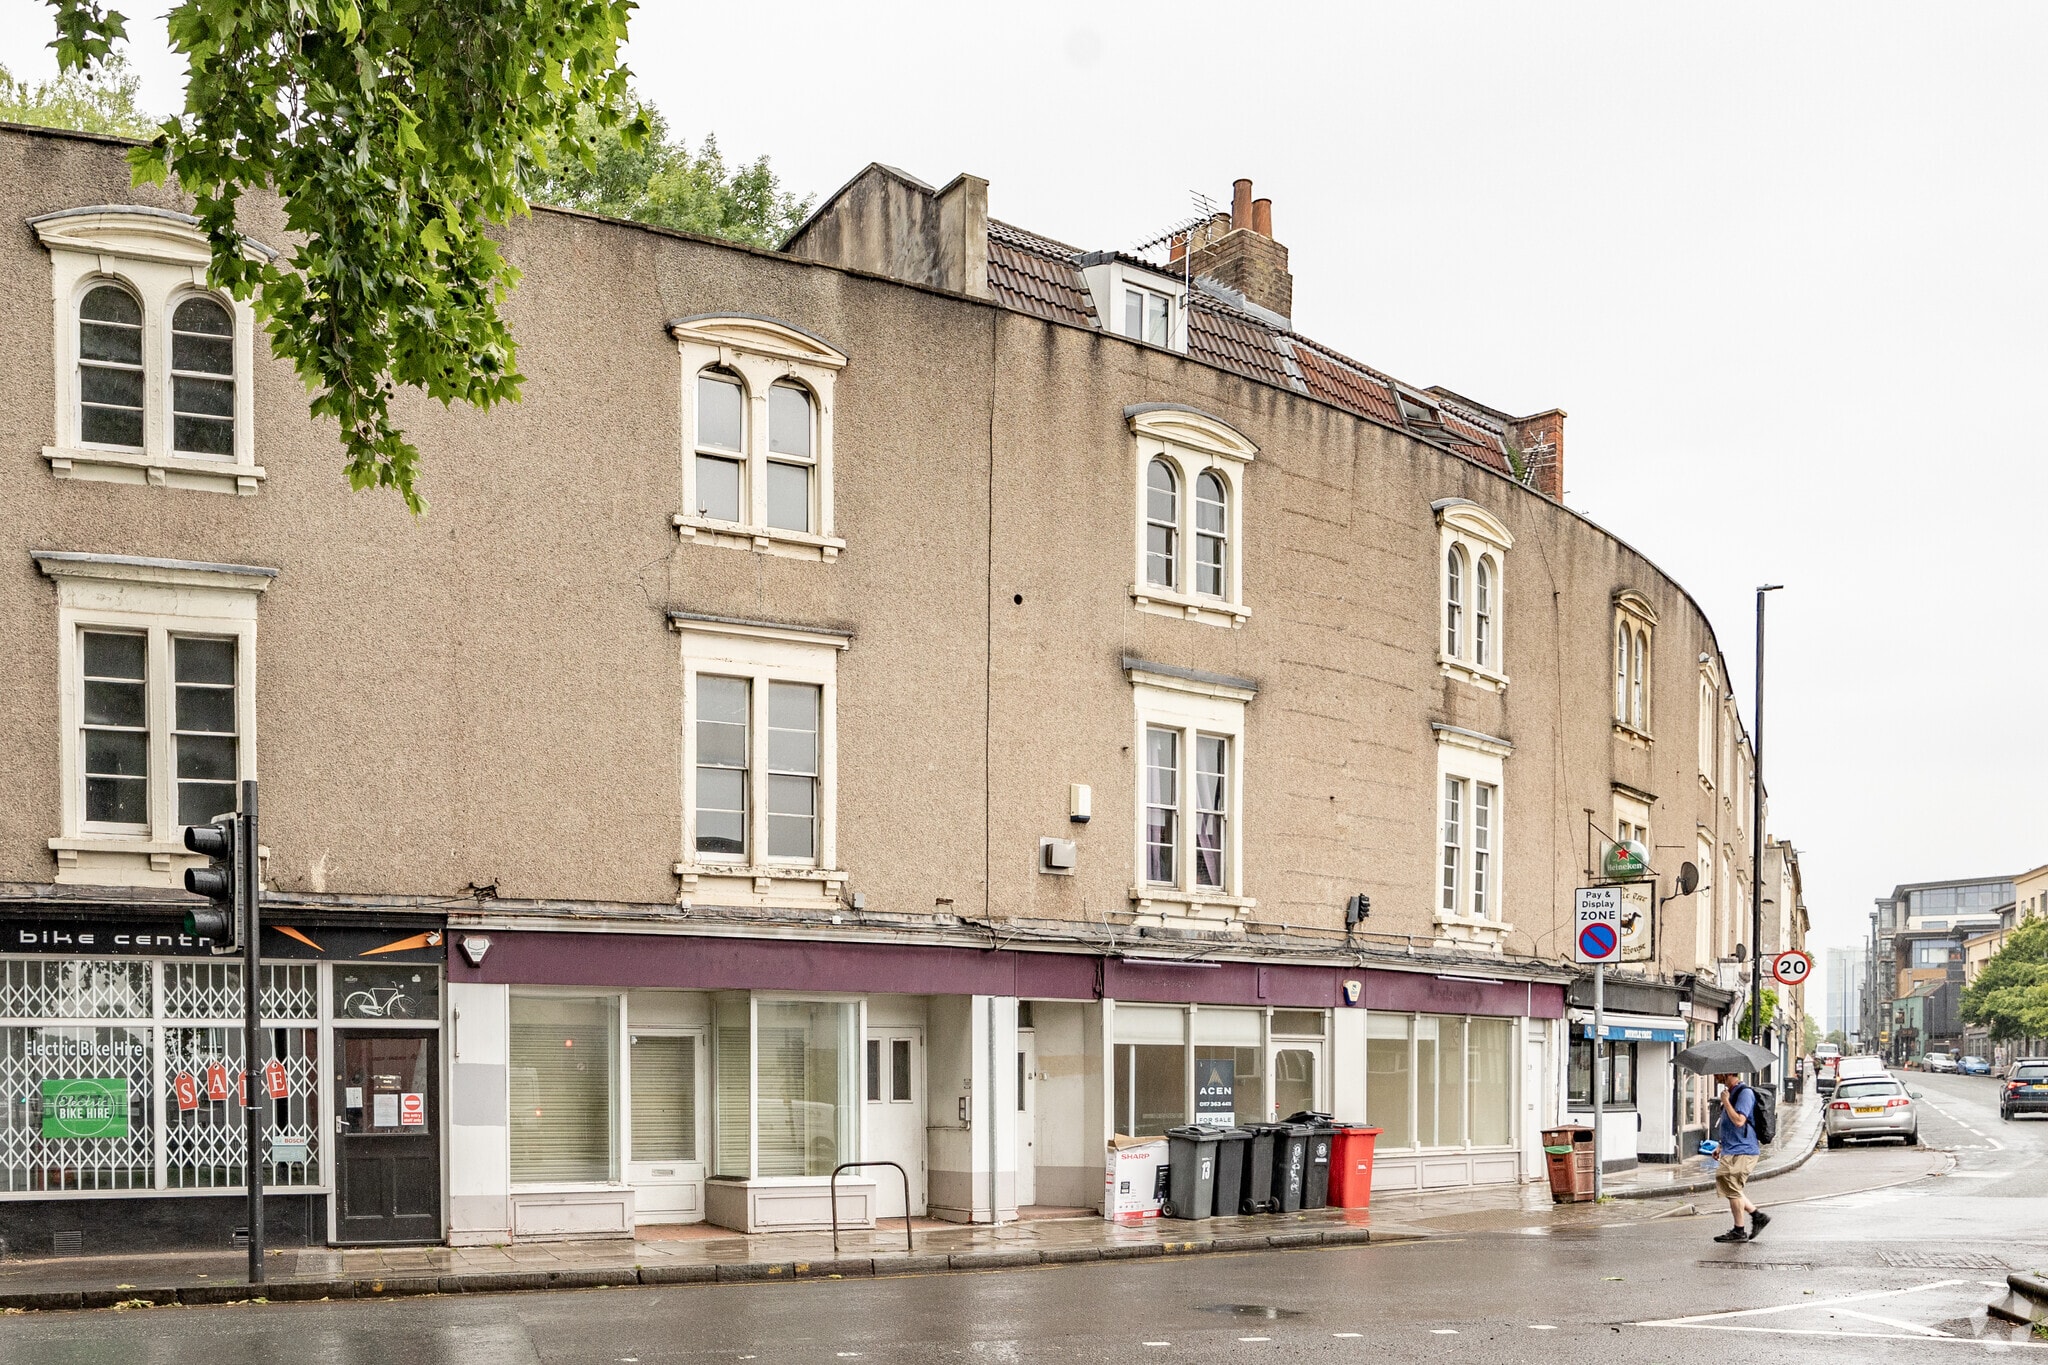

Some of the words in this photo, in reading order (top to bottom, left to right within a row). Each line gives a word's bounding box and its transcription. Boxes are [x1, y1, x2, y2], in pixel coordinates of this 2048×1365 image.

[1607, 863, 1643, 871] Heineken
[1586, 891, 1601, 899] Pay
[1582, 900, 1615, 909] Display
[1581, 910, 1616, 920] ZONE
[20, 930, 95, 944] bike
[114, 933, 242, 949] centr
[1780, 961, 1806, 974] 20
[81, 1041, 110, 1056] Bike
[115, 1041, 143, 1056] Hire
[1200, 1087, 1232, 1095] ACEN
[59, 1096, 107, 1107] Electric
[59, 1108, 83, 1119] BIKE
[86, 1108, 110, 1119] HIRE
[1201, 1161, 1211, 1180] 13
